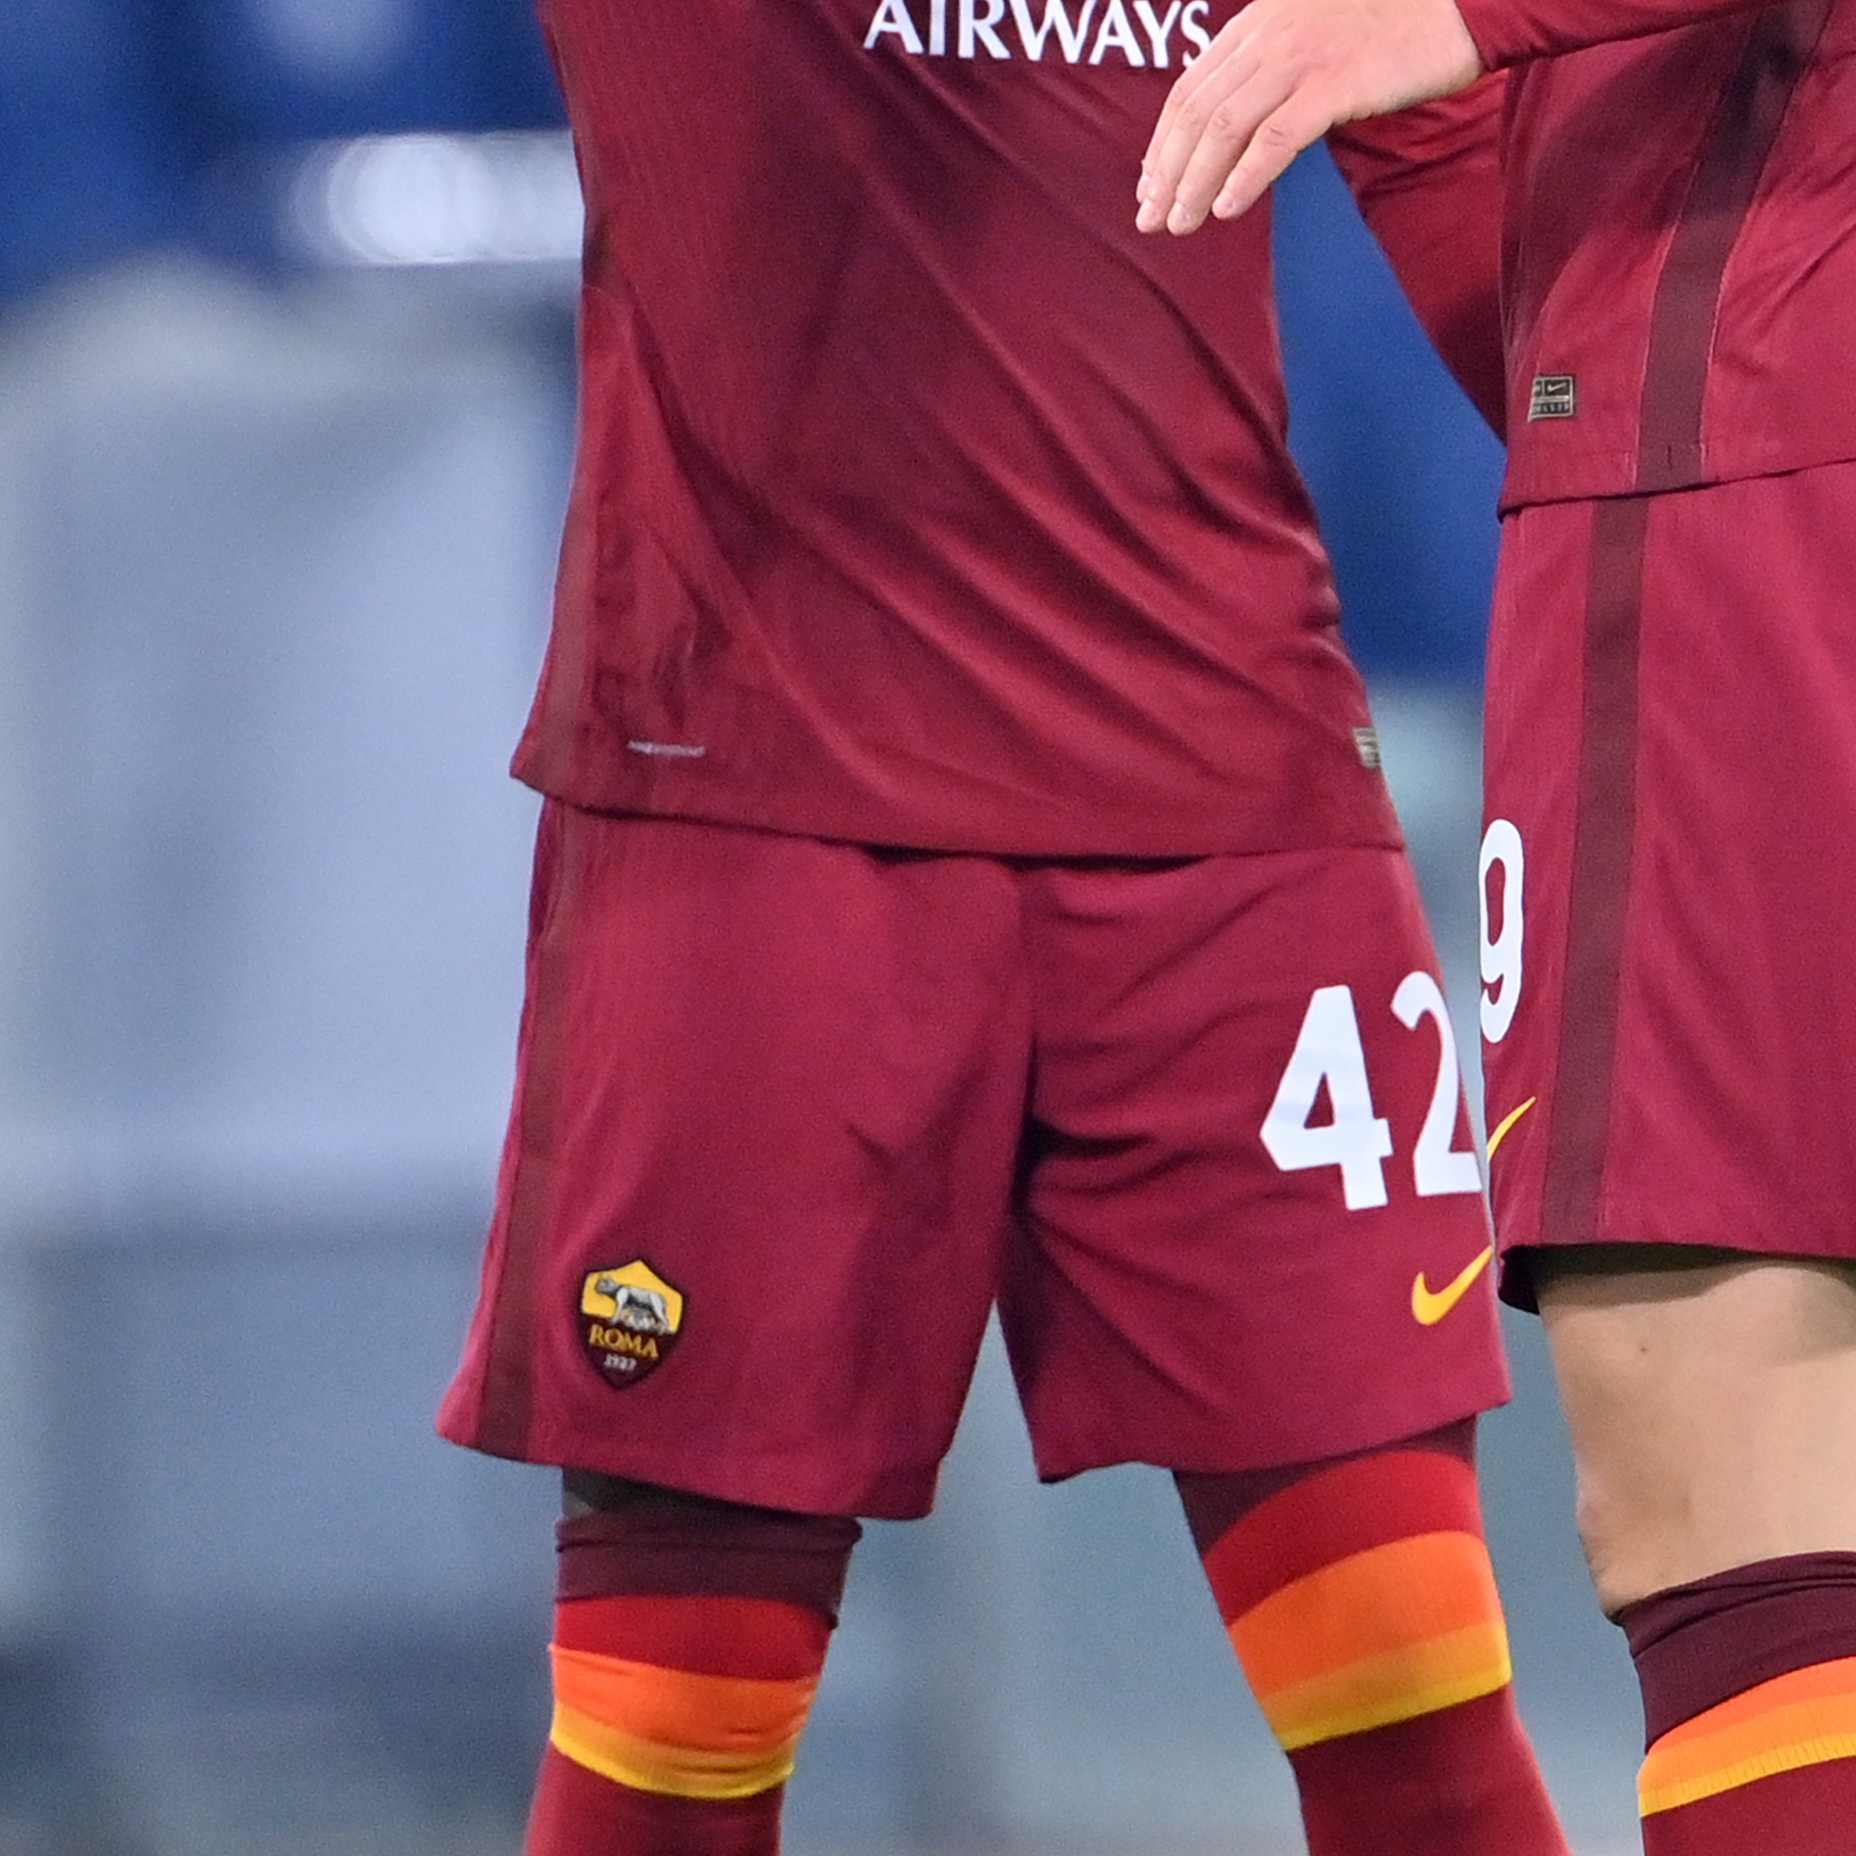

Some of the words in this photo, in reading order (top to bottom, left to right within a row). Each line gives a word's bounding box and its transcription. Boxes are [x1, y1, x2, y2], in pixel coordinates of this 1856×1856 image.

[1478, 819, 1524, 1042] 9
[1259, 970, 1482, 1210] 42
[589, 1324, 659, 1358] ROMA
